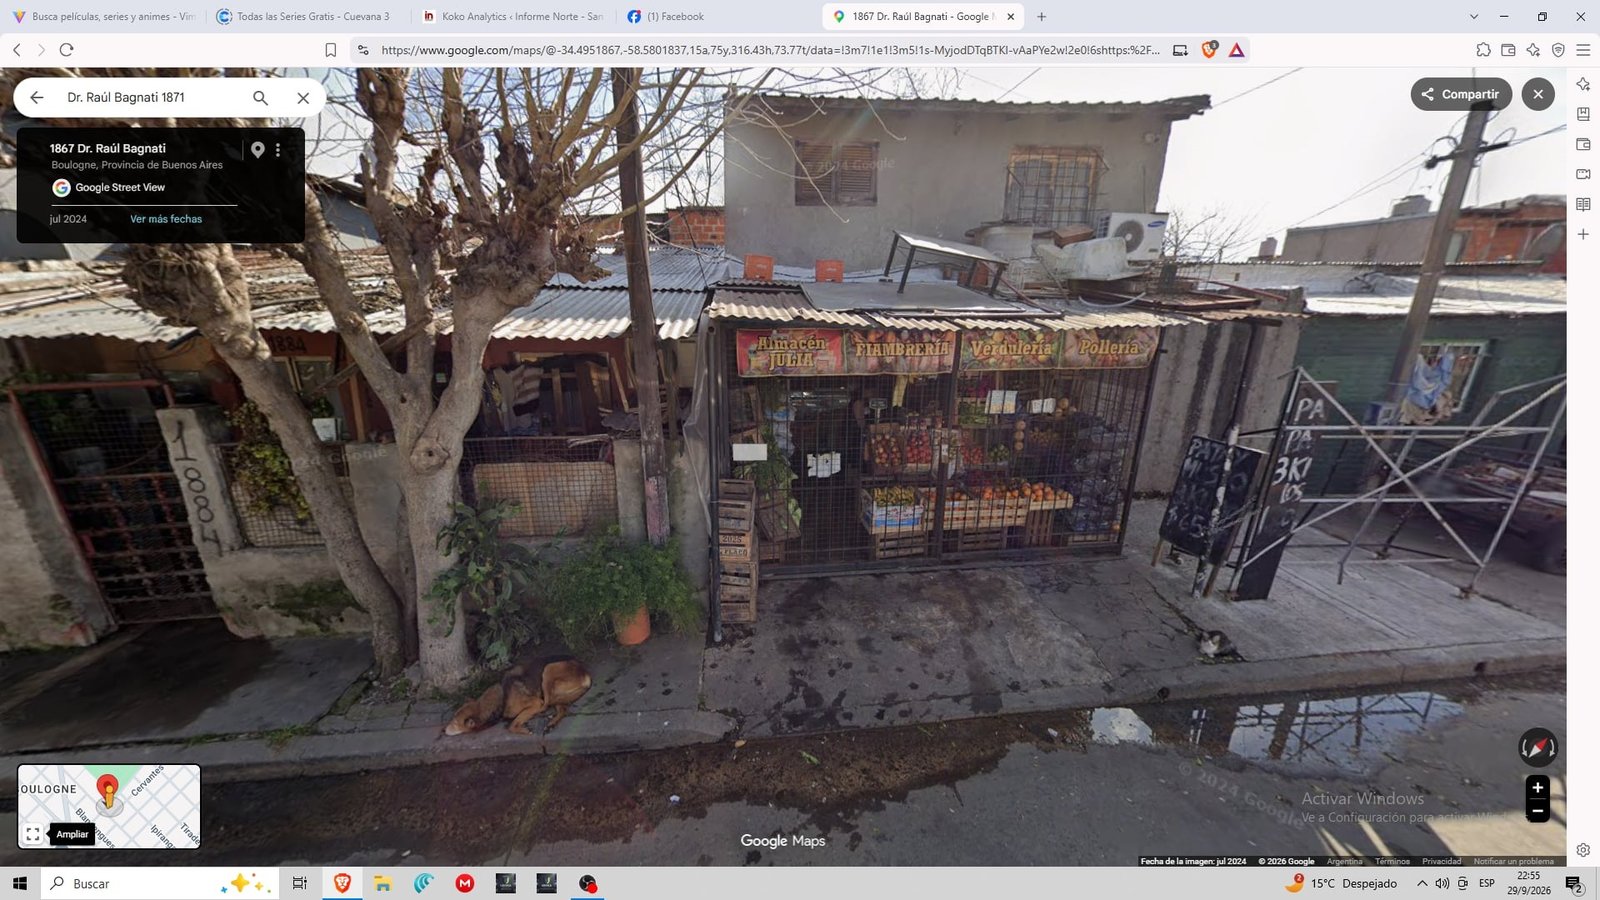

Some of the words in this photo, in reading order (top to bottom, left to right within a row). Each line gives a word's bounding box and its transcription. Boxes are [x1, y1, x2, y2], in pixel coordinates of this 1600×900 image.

[33, 12, 58, 20] Busca
[61, 12, 100, 22] películas,
[104, 12, 128, 20] series
[131, 15, 136, 23] y
[139, 12, 170, 20] animes
[238, 12, 263, 20] Todas
[280, 12, 306, 20] Series
[309, 12, 334, 20] Gratis
[344, 12, 381, 20] Cuevana
[384, 12, 389, 20] 3
[443, 12, 465, 20] Koko
[467, 12, 506, 23] Analytics
[516, 12, 550, 20] Informe
[553, 12, 578, 20] Norte
[648, 12, 659, 22] (1)
[662, 12, 704, 20] Facebook
[853, 12, 874, 20] 1867
[877, 12, 889, 20] Dr.
[893, 12, 911, 20] Raúl
[915, 12, 947, 23] Bagnati
[957, 12, 988, 23] Google
[68, 92, 82, 102] Dr.
[87, 92, 110, 102] Raúl
[115, 92, 158, 105] Bagnati
[162, 92, 184, 102] 1871
[1442, 89, 1500, 102] Compartir
[50, 144, 74, 153] 1867
[78, 144, 92, 153] Dr.
[96, 143, 120, 153] Raúl
[123, 143, 165, 156] Bagnati
[52, 160, 98, 171] Boulogne,
[102, 160, 144, 169] Provincia
[147, 160, 159, 169] de
[162, 161, 197, 169] Buenos
[199, 160, 223, 169] Aires
[76, 183, 110, 194] Google
[112, 183, 140, 191] Street
[143, 183, 165, 191] View
[50, 214, 60, 225] jul
[64, 215, 87, 223] 2024
[131, 215, 146, 223] Ver
[149, 214, 168, 223] más
[171, 214, 202, 223] fechas
[757, 335, 826, 351] Almacén
[855, 339, 950, 357] FIAMBRERÍA
[971, 339, 1052, 356] Verdulería
[1079, 338, 1138, 354] Pollería
[768, 351, 814, 370] JULIA
[1295, 397, 1324, 421] PA
[173, 420, 224, 556] 1884
[131, 765, 164, 797] Cervantes
[18, 785, 77, 793] OULOGNE
[57, 830, 89, 839] Ampliar
[1518, 871, 1540, 879] 22:55
[74, 879, 109, 889] Buscar
[1312, 879, 1334, 888] 15°C
[1343, 879, 1397, 890] Despejado
[1480, 879, 1495, 887] ESP
[1508, 886, 1551, 895] 29/9/2026
